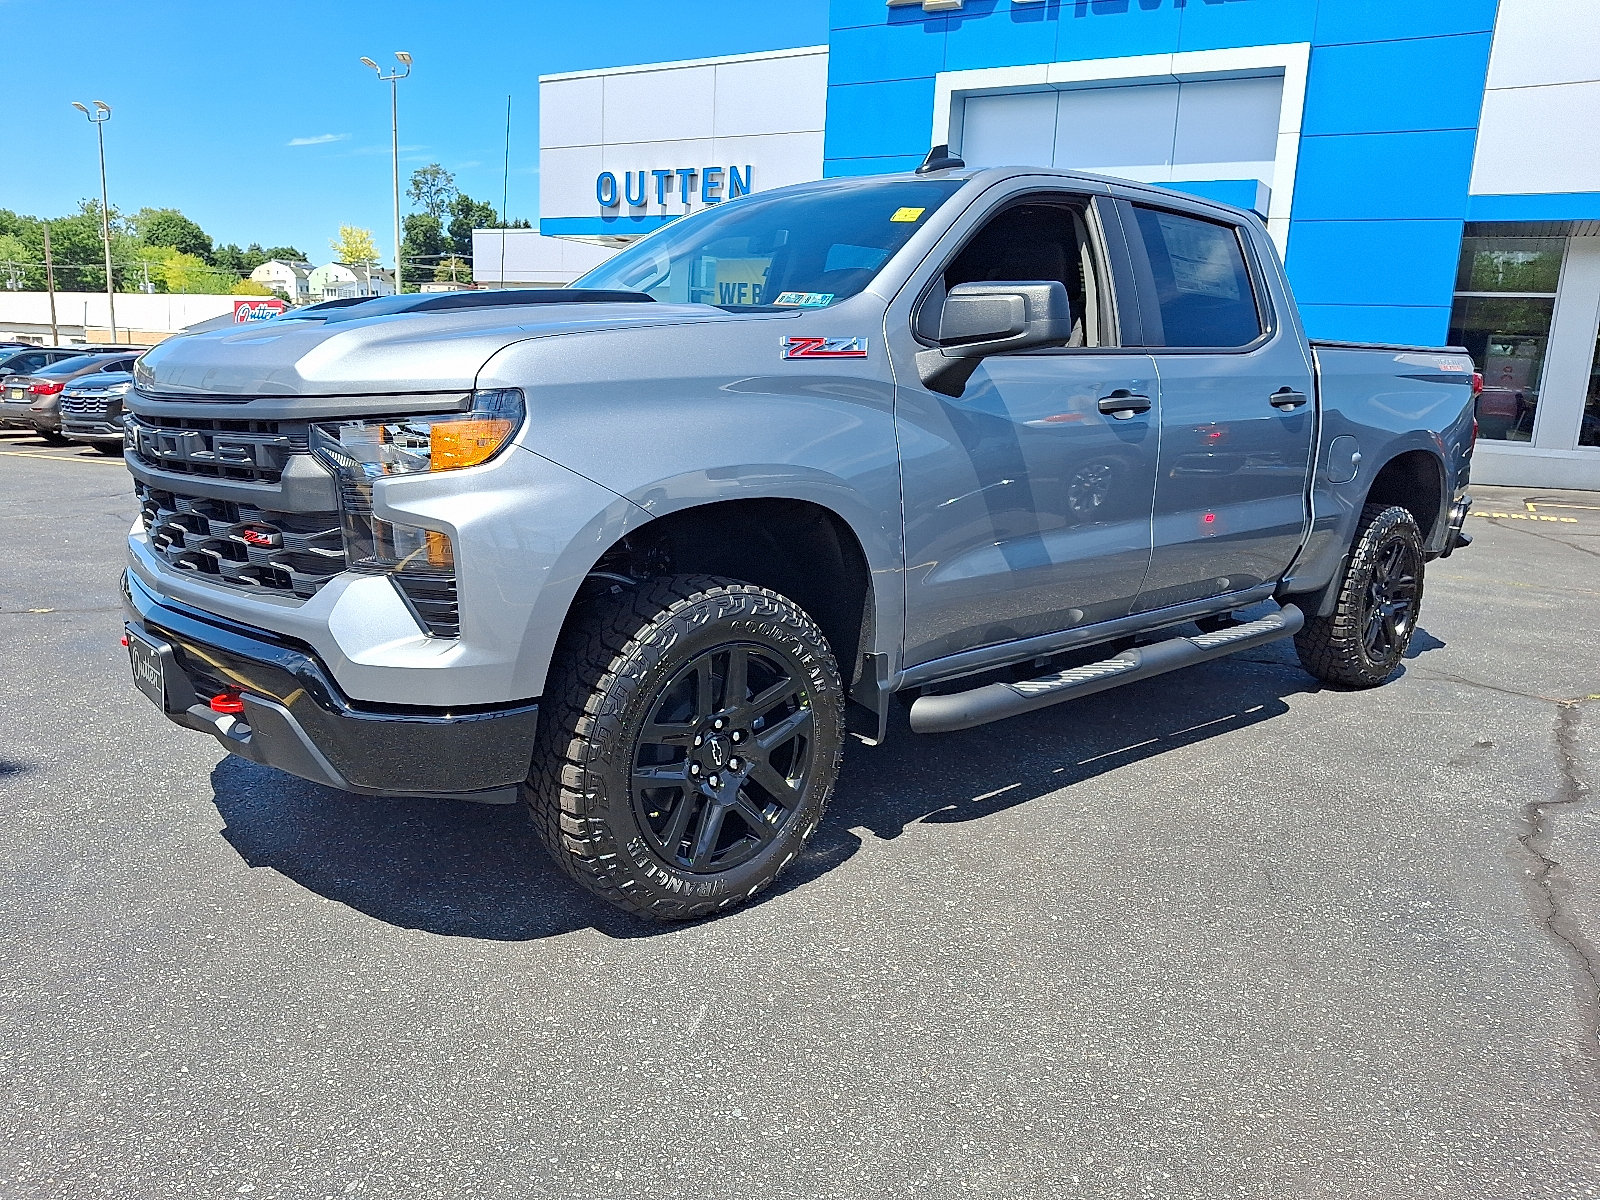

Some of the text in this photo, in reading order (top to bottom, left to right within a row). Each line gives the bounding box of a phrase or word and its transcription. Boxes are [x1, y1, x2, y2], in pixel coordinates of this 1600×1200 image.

[596, 165, 752, 207] OUTTEN
[780, 335, 868, 359] Z71
[1467, 511, 1578, 523] ARKING
[132, 646, 162, 692] Outten
[731, 619, 828, 693] GOODYEAR
